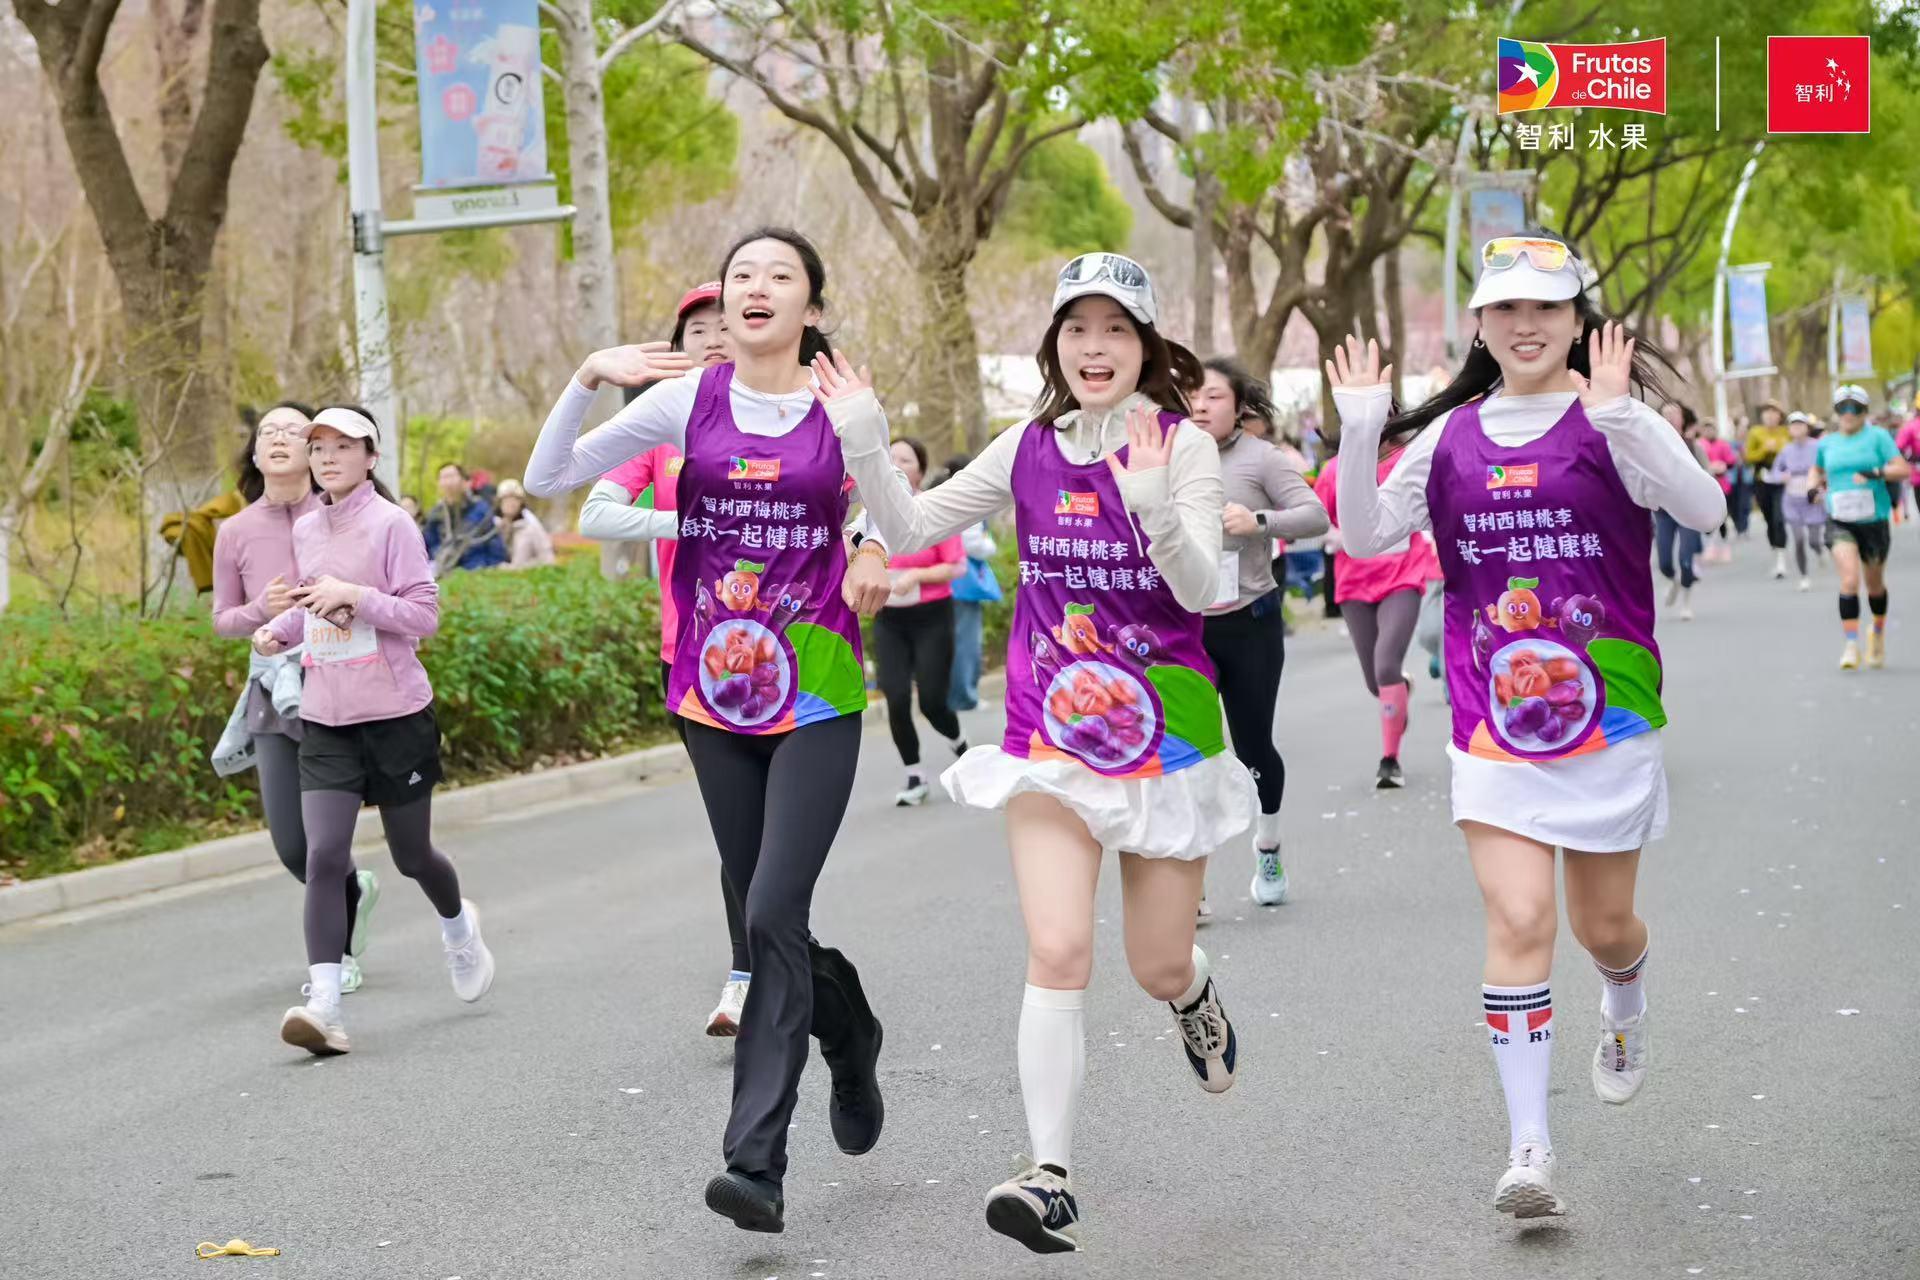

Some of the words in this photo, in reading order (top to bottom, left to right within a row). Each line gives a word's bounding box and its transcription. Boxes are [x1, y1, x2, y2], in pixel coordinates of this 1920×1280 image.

[701, 495, 807, 520] 智利西梅桃李
[681, 516, 830, 550] 每天一起健康紫
[1463, 508, 1573, 533] 智利西梅桃李
[1028, 534, 1129, 561] 智利西梅桃李
[1493, 1034, 1510, 1045] de
